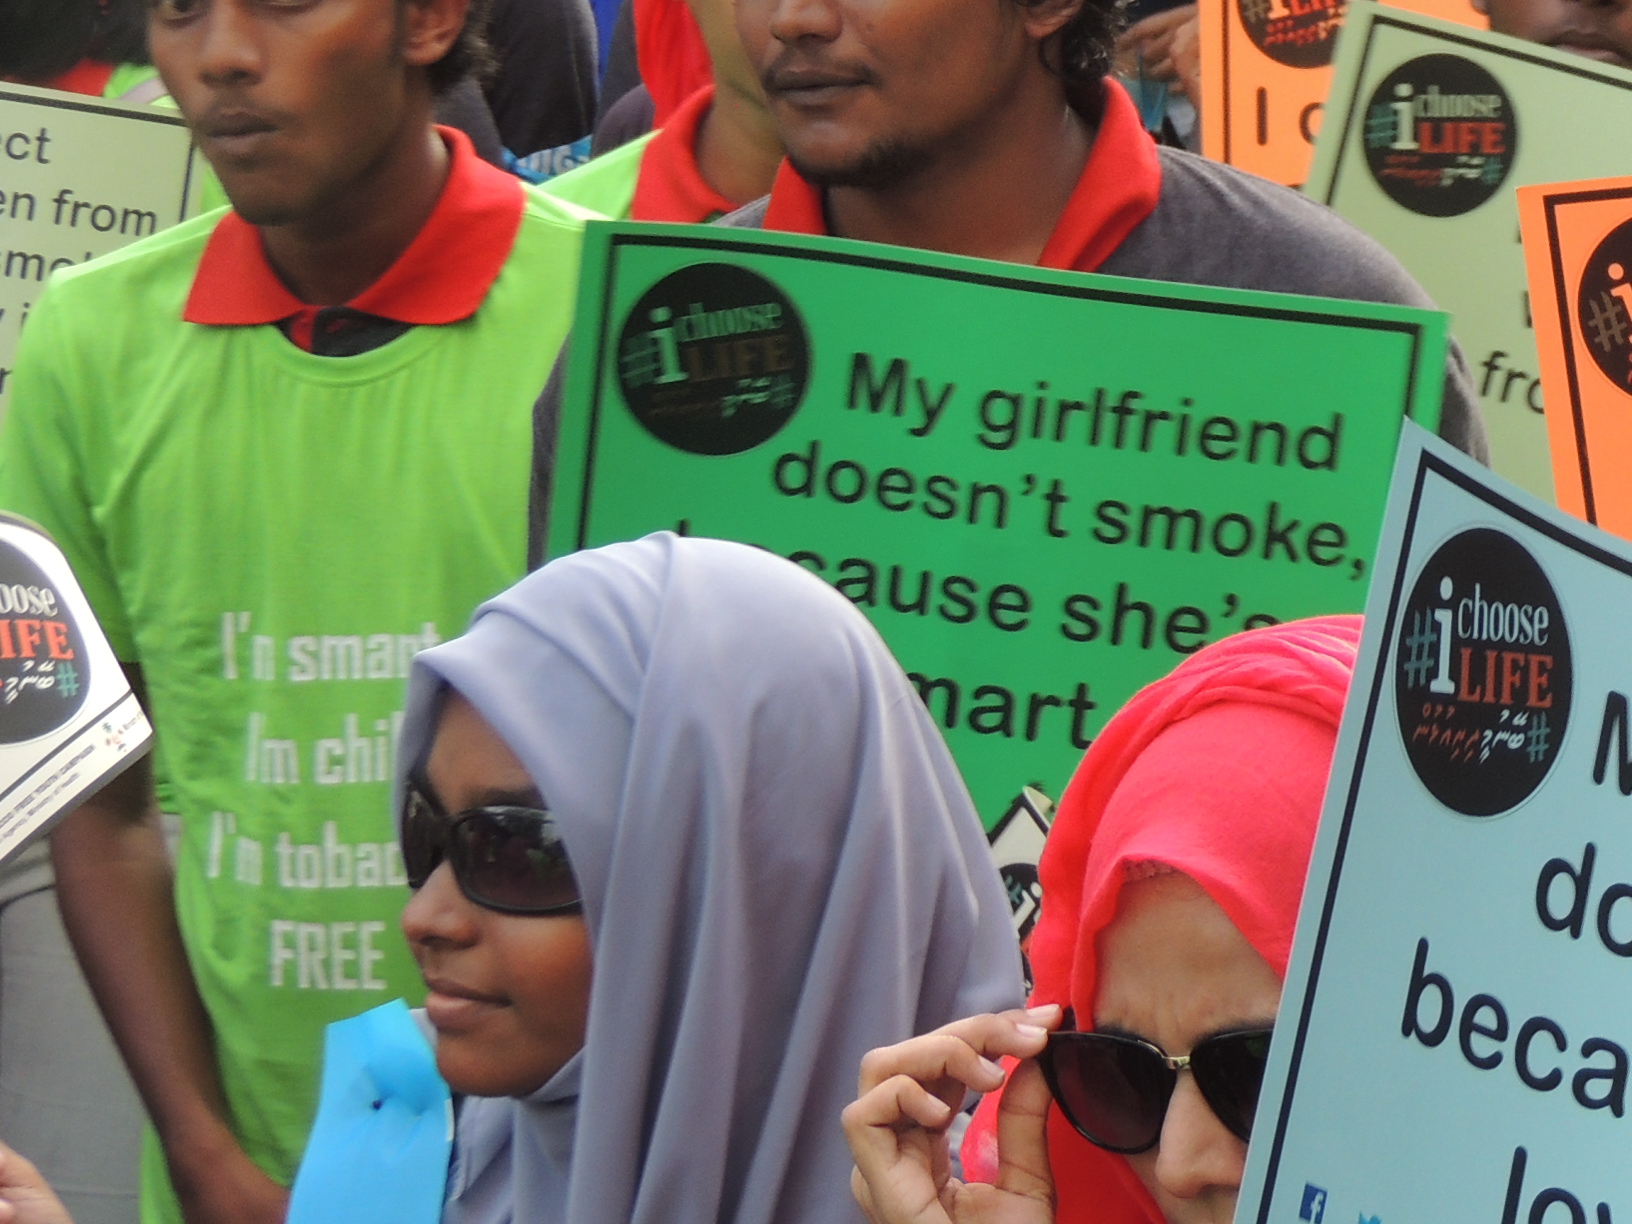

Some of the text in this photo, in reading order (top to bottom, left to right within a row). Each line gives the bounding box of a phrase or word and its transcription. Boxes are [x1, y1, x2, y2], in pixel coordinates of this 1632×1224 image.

[1418, 121, 1507, 155] LIFE
[52, 189, 157, 237] from
[845, 352, 1347, 473] My girlfriend
[773, 440, 1368, 581] doesn't smoke,
[1457, 582, 1549, 646] choose
[1457, 646, 1554, 709] LIFE
[270, 919, 388, 992] FREE
